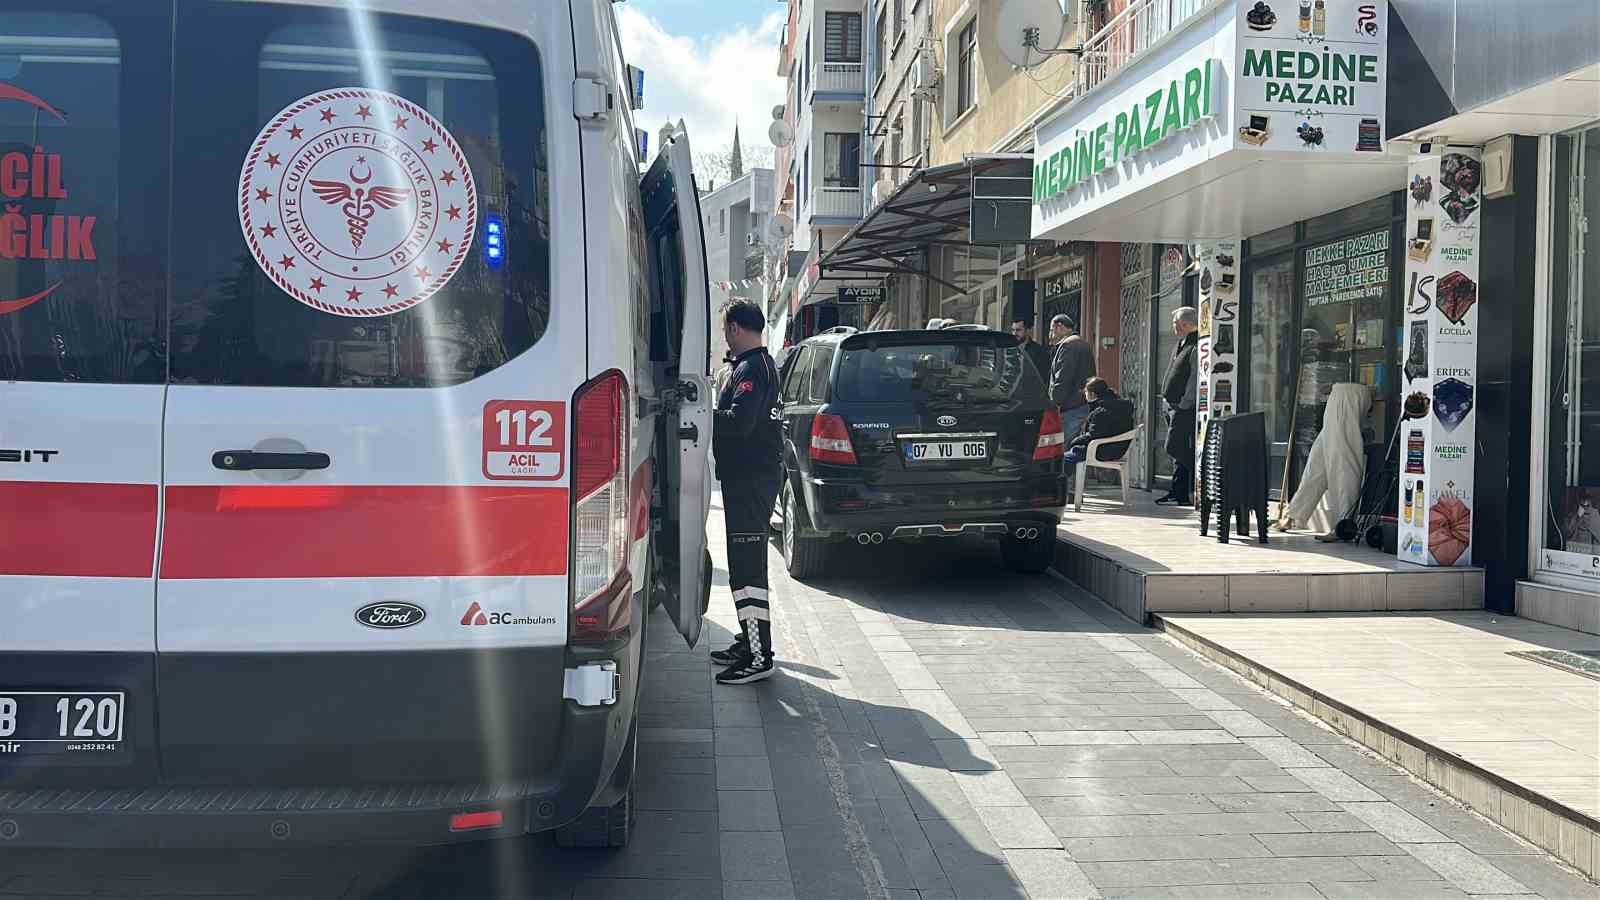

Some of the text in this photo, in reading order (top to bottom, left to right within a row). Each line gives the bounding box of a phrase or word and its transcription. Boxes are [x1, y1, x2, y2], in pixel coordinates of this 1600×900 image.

[1242, 46, 1378, 83] MEDİNE
[1265, 82, 1355, 106] PAZARI
[1032, 58, 1212, 206] MEDİNE PAZARI
[286, 132, 377, 192] CUMHURİYETİ
[384, 139, 427, 185] SAĞLIK
[285, 198, 323, 261] TÜRKİYE
[1305, 230, 1389, 268] MEKKE PAZARI
[1331, 263, 1347, 278] ve
[495, 409, 553, 446] 112
[913, 444, 927, 458] 07
[938, 443, 953, 457] VU
[963, 443, 985, 457] 006
[489, 611, 556, 625] ac ambulans
[56, 697, 117, 737] 120
